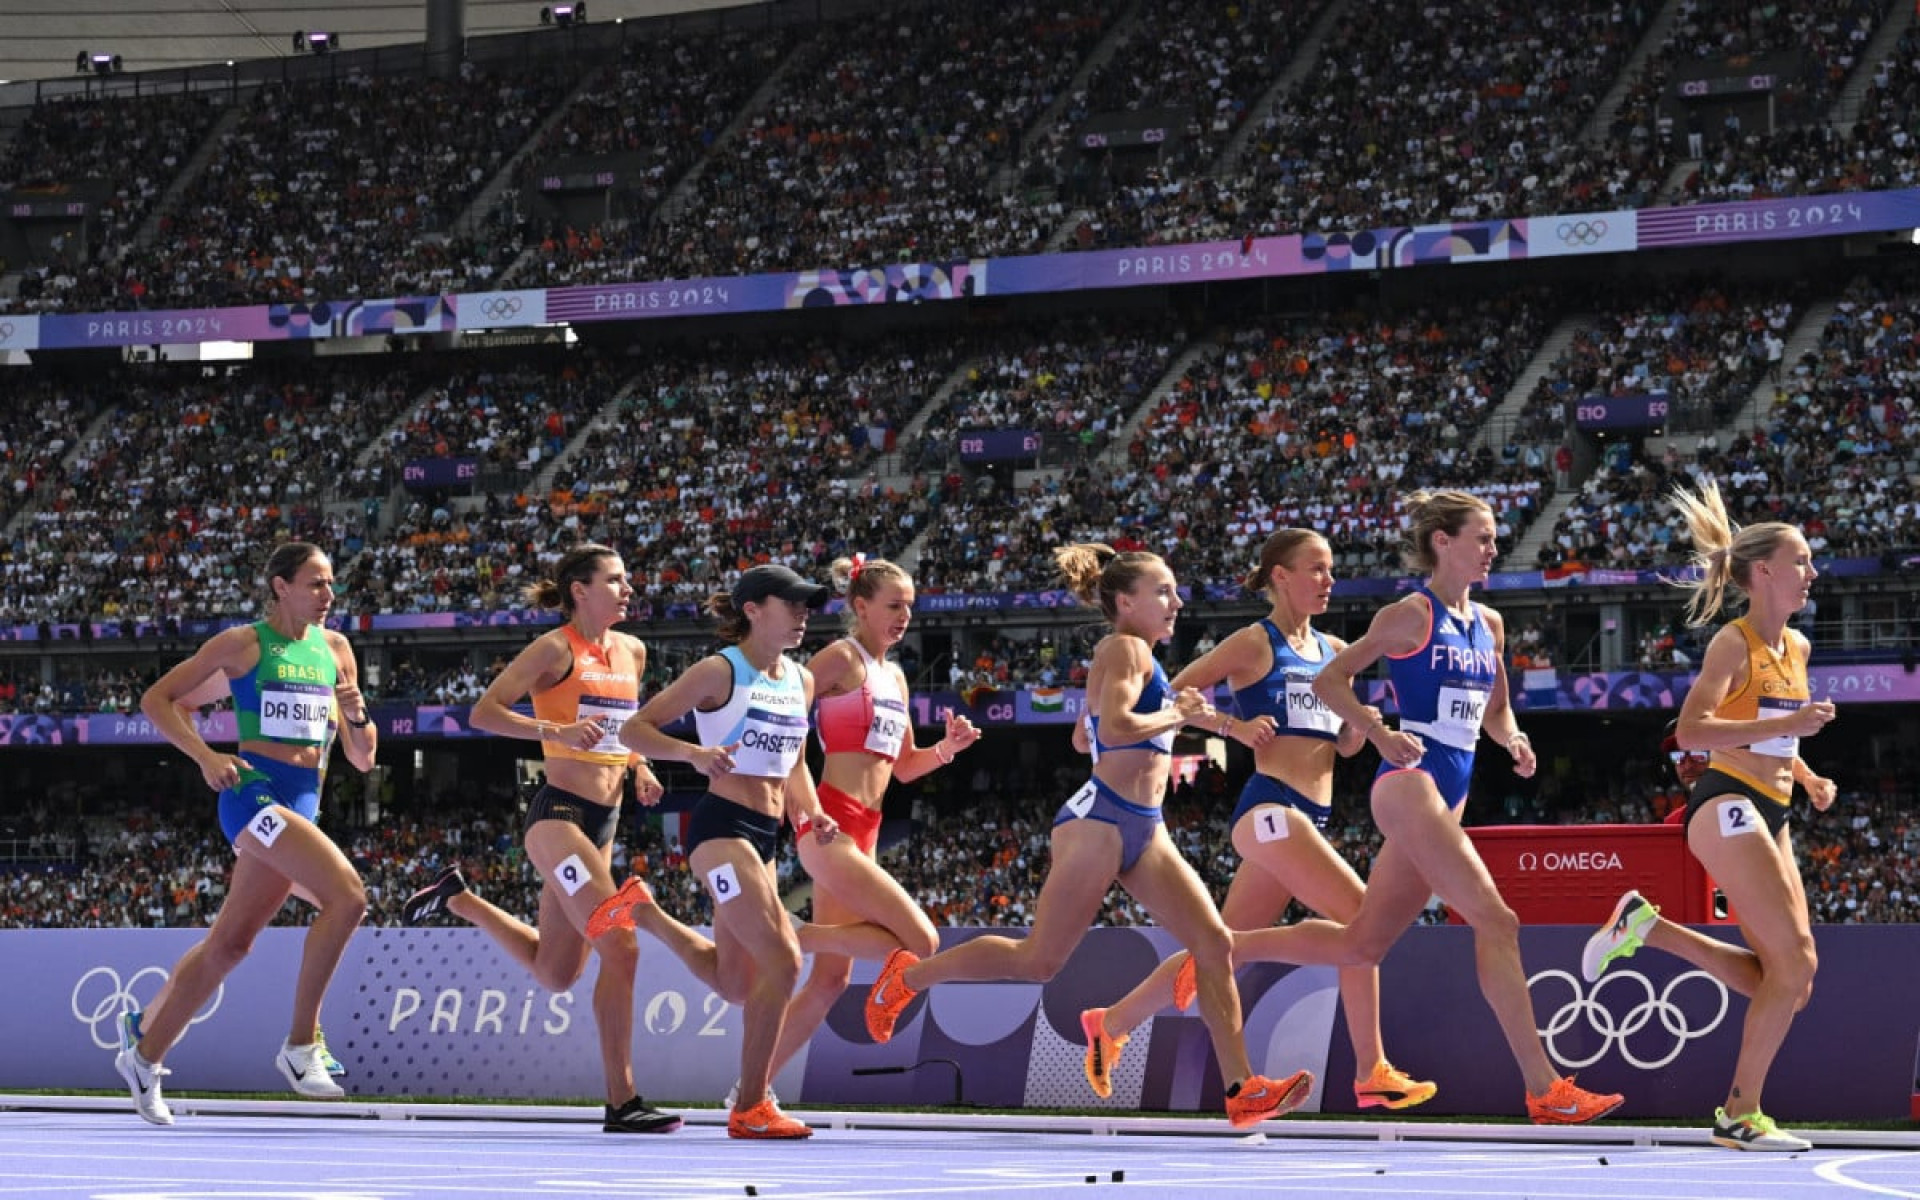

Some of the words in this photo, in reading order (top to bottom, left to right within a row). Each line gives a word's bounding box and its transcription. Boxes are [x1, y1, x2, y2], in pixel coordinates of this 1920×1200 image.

[1695, 210, 1777, 233] PARIS
[1787, 202, 1862, 228] 2024
[1118, 255, 1191, 276] PARIS
[594, 291, 660, 312] PARIS
[668, 287, 729, 307] 2024
[88, 320, 152, 338] PARIS
[162, 317, 220, 336] 2024
[1577, 405, 1607, 420] E10
[1828, 676, 1892, 693] 2024
[264, 701, 289, 719] DA
[987, 704, 1014, 719] C8
[115, 721, 159, 736] PARI
[392, 719, 414, 734] H2
[256, 815, 279, 838] 12
[1264, 813, 1276, 834] 1
[1728, 806, 1746, 828] 2
[1543, 852, 1623, 870] OMEGA
[563, 864, 577, 884] 9
[716, 874, 730, 894] 6
